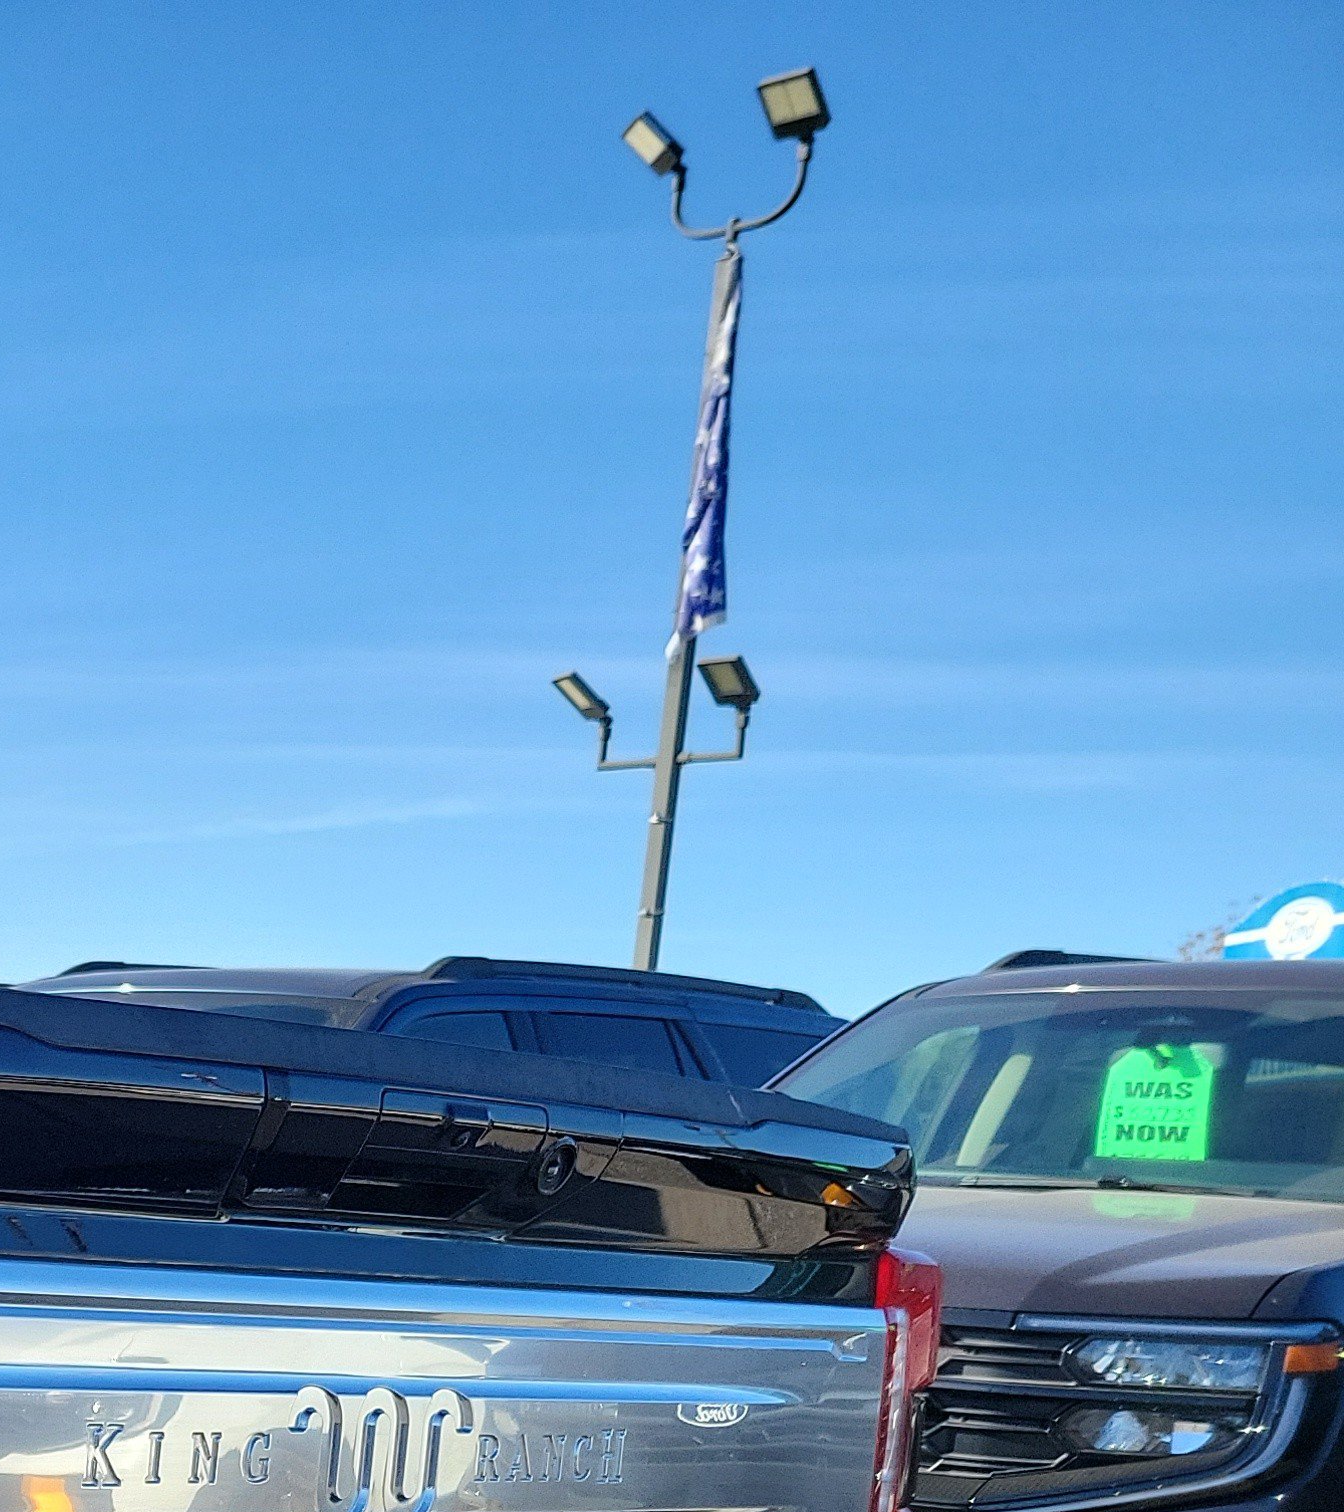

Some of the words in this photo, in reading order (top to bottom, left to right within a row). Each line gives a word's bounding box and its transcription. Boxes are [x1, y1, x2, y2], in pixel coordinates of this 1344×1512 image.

[1125, 1082, 1193, 1100] WAS
[1115, 1124, 1190, 1143] NOW
[81, 1422, 272, 1488] KING
[473, 1428, 628, 1484] RANCH
